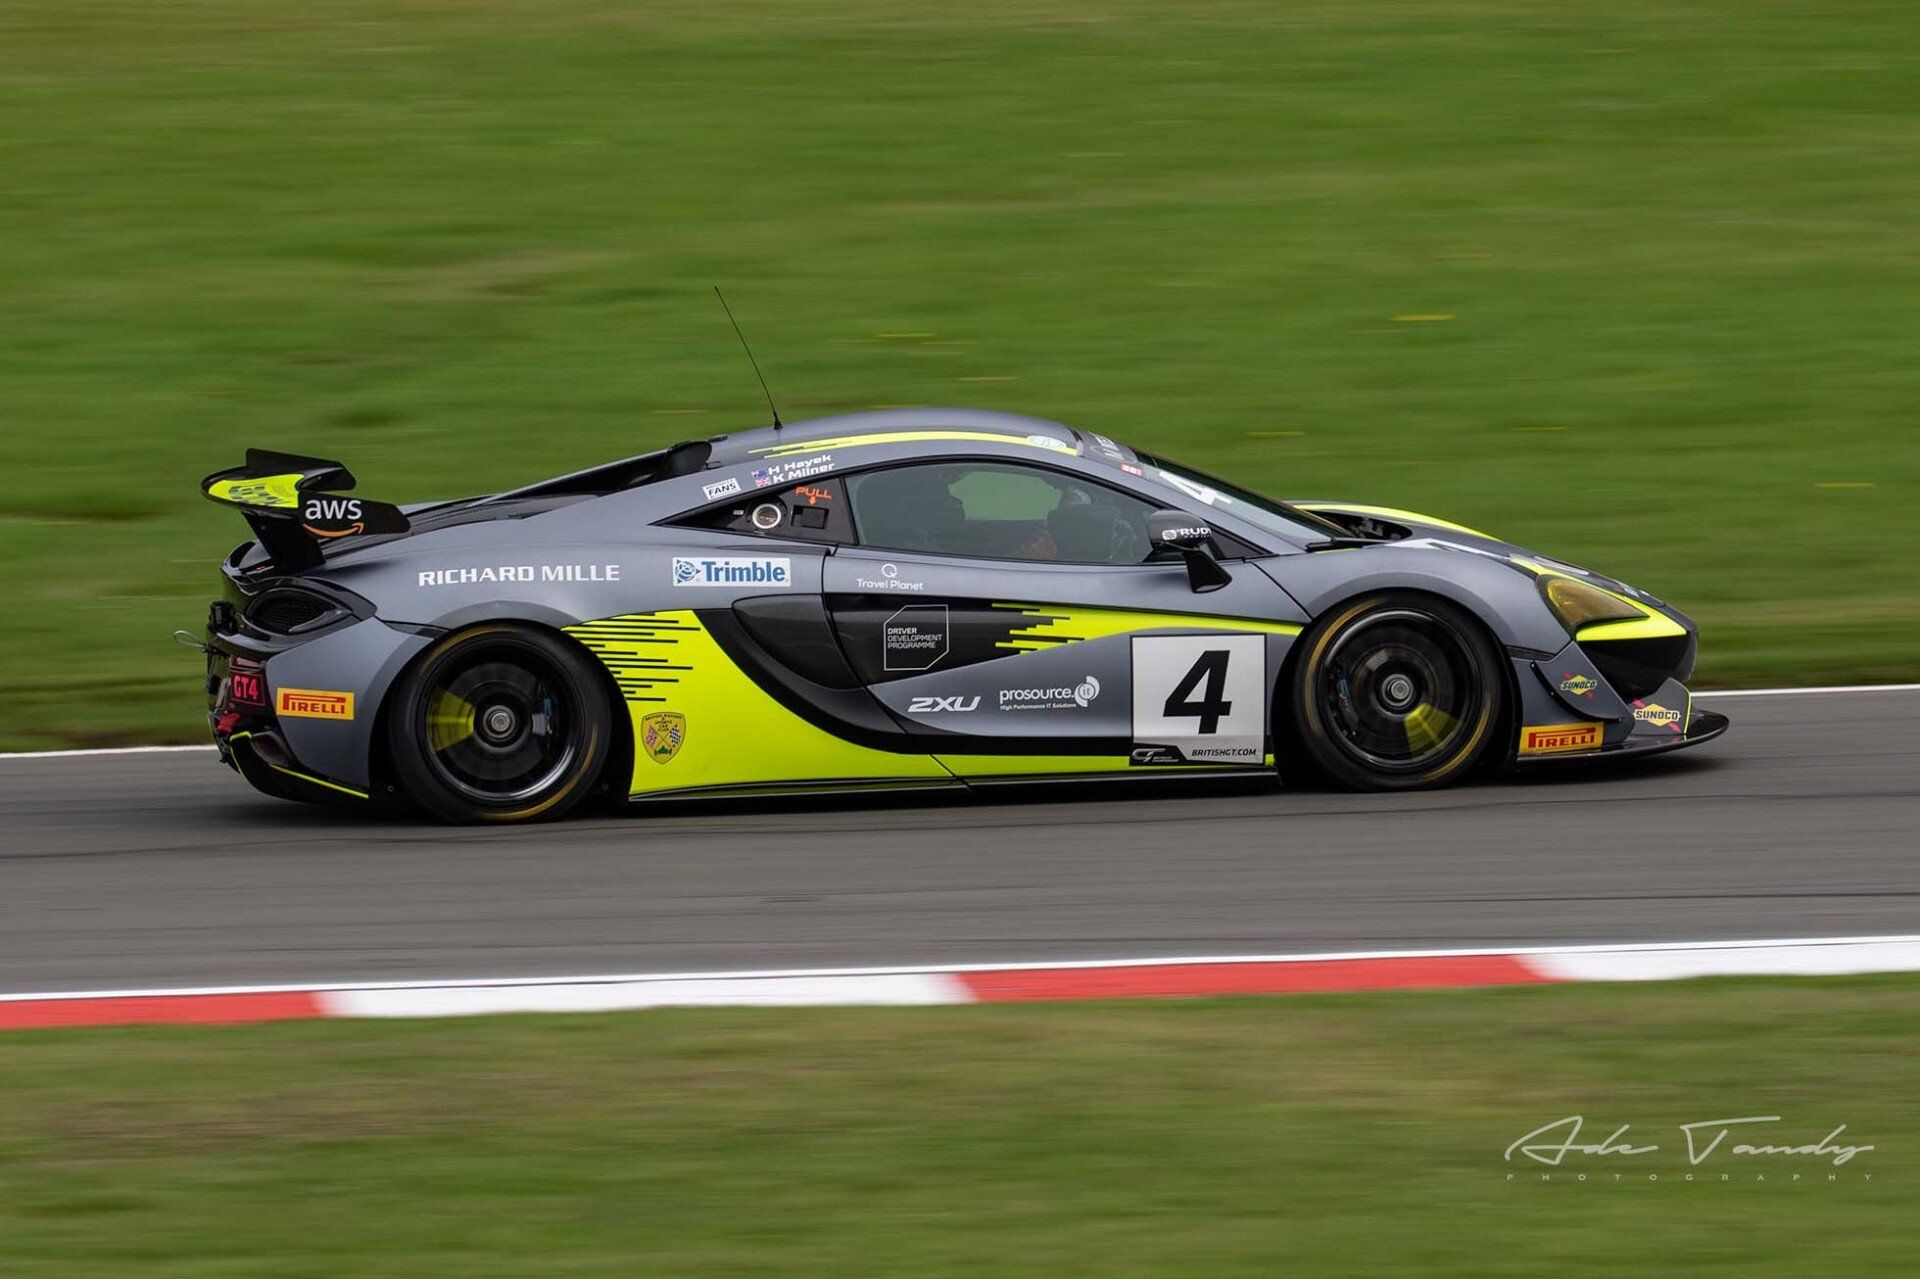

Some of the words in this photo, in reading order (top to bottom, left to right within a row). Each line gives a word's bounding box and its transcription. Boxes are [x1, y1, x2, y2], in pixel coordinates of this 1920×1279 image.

[768, 466, 780, 475] H
[773, 473, 785, 483] K
[788, 463, 835, 480] Milner
[708, 483, 737, 496] FANS
[795, 486, 832, 499] PULL
[305, 499, 362, 520] aws
[418, 566, 534, 587] RICHARD
[542, 564, 620, 582] MILLE
[701, 561, 786, 582] Trimble
[857, 578, 888, 589] Travel
[890, 580, 924, 590] Planet
[887, 627, 917, 635] DRIVER
[887, 634, 942, 642] DEVELOPMENT
[887, 641, 936, 649] PROGRAMME
[233, 675, 259, 700] GT4
[1162, 650, 1232, 735] 4
[1561, 681, 1597, 691] SUNOCO
[283, 692, 347, 715] PIRELLI
[907, 696, 981, 713] 2XU
[1635, 709, 1679, 721] SUNOCO
[1528, 727, 1597, 749] PIRELLI
[1191, 748, 1257, 757] BRITISHGT.COM
